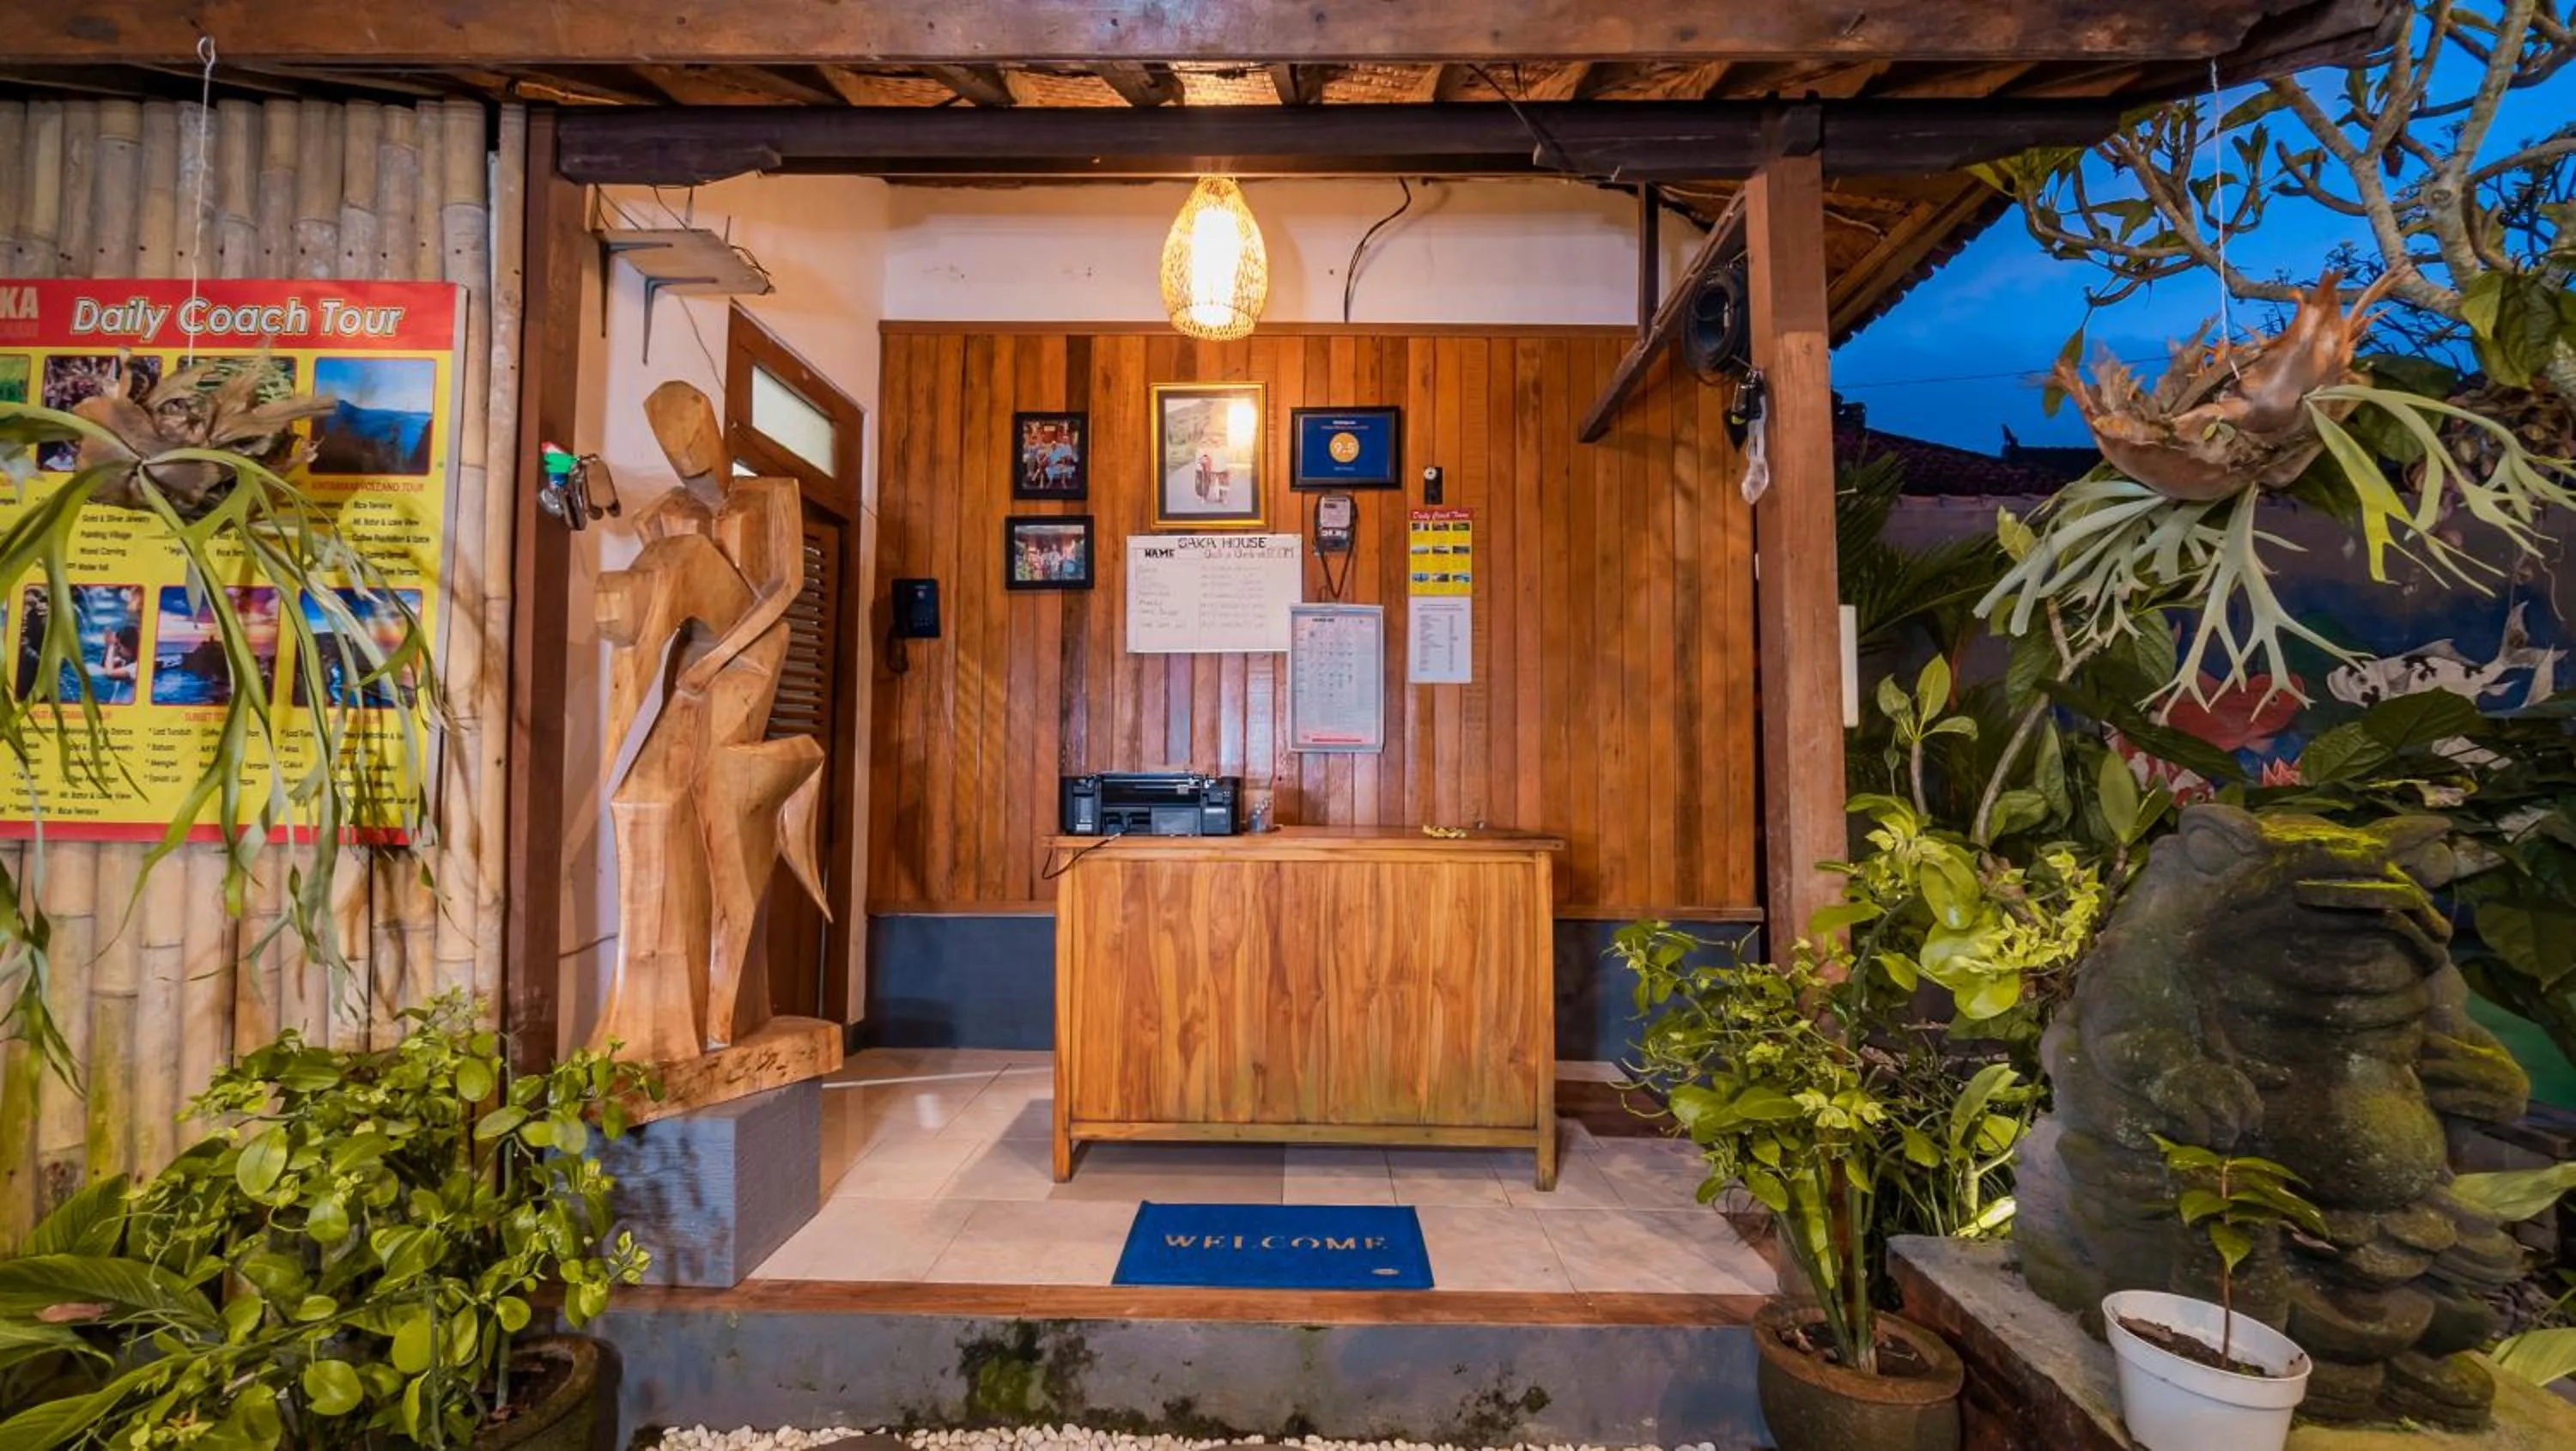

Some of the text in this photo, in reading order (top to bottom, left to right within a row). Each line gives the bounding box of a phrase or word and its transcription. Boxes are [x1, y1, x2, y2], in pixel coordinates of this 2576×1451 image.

[71, 297, 171, 342] Daily
[177, 296, 309, 336] Coach
[319, 299, 404, 337] Tour
[1222, 537, 1268, 549] HOUSE
[1145, 549, 1175, 558] NAME
[1164, 1234, 1388, 1251] WELCOME
